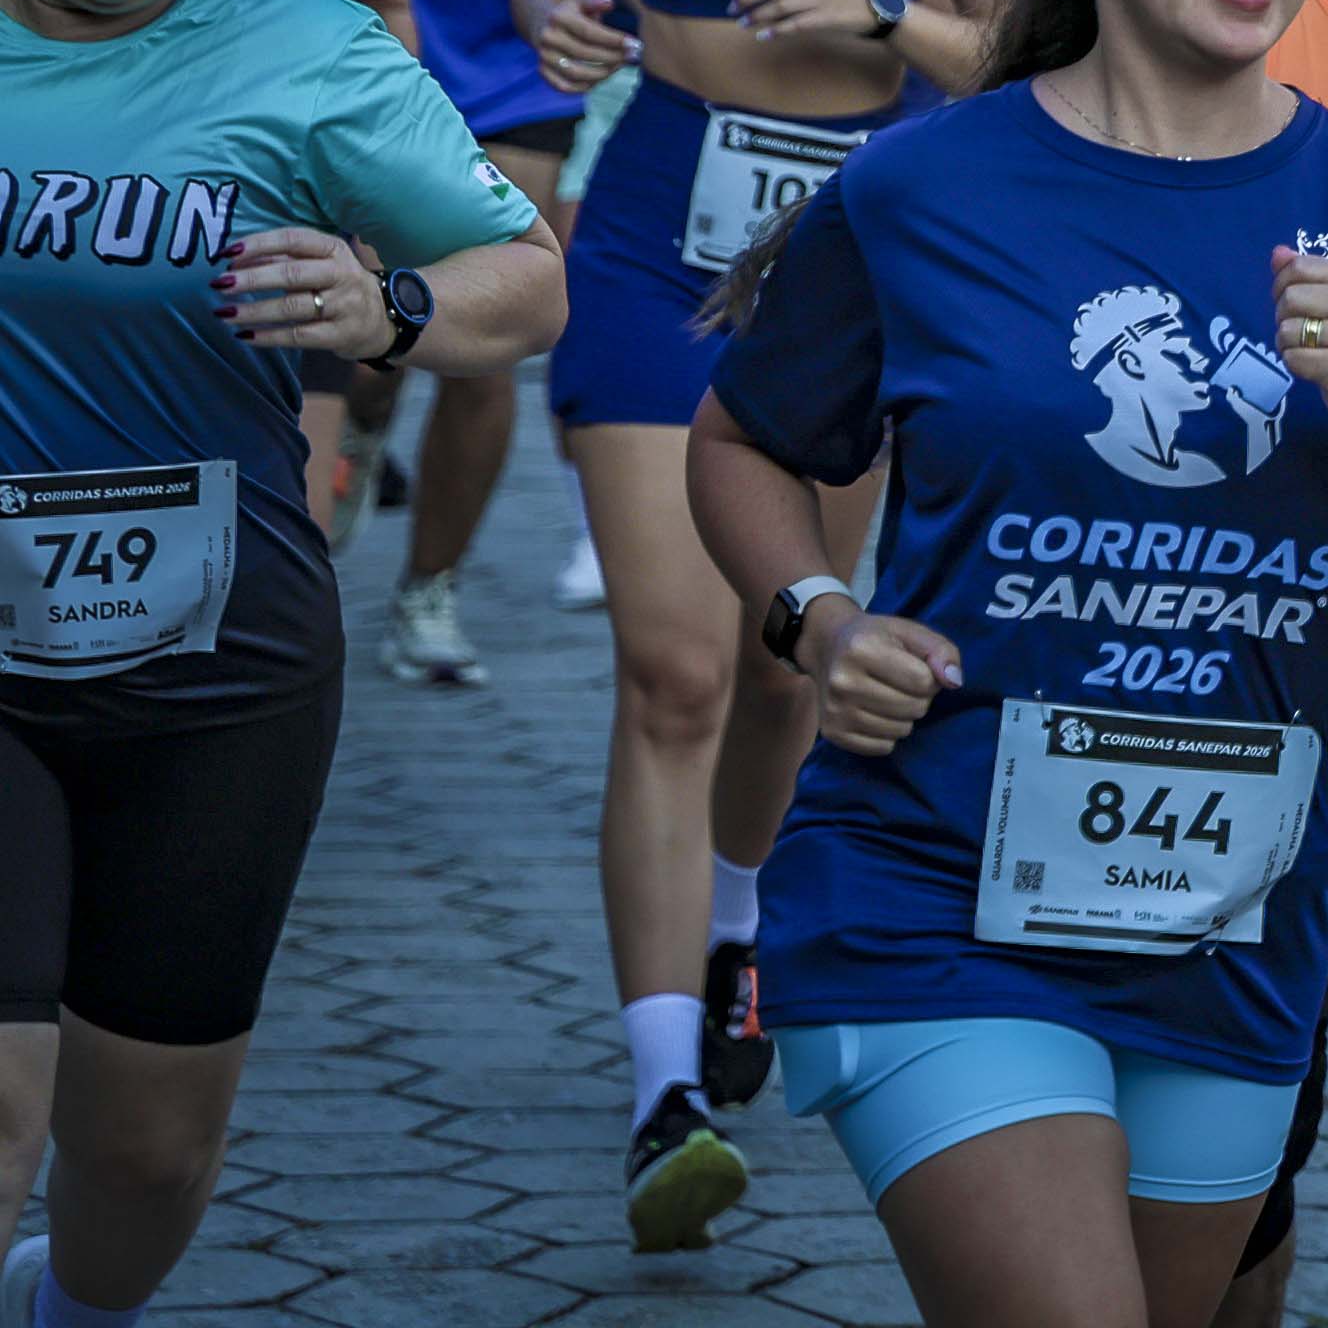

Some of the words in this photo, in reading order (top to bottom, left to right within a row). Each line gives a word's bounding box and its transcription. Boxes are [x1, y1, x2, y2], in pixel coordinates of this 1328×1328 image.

[752, 167, 826, 210] 10
[33, 487, 101, 503] CORRIDAS
[103, 484, 164, 499] SANEPAR
[33, 526, 158, 589] 749
[48, 598, 148, 623] SANDRA
[1081, 641, 1232, 696] 2026
[1099, 732, 1175, 752] CORRIDAS
[1176, 738, 1242, 757] SANEPAR
[1242, 744, 1271, 759] 2026
[997, 787, 1012, 836] VOLUMES
[1078, 780, 1233, 856] 844
